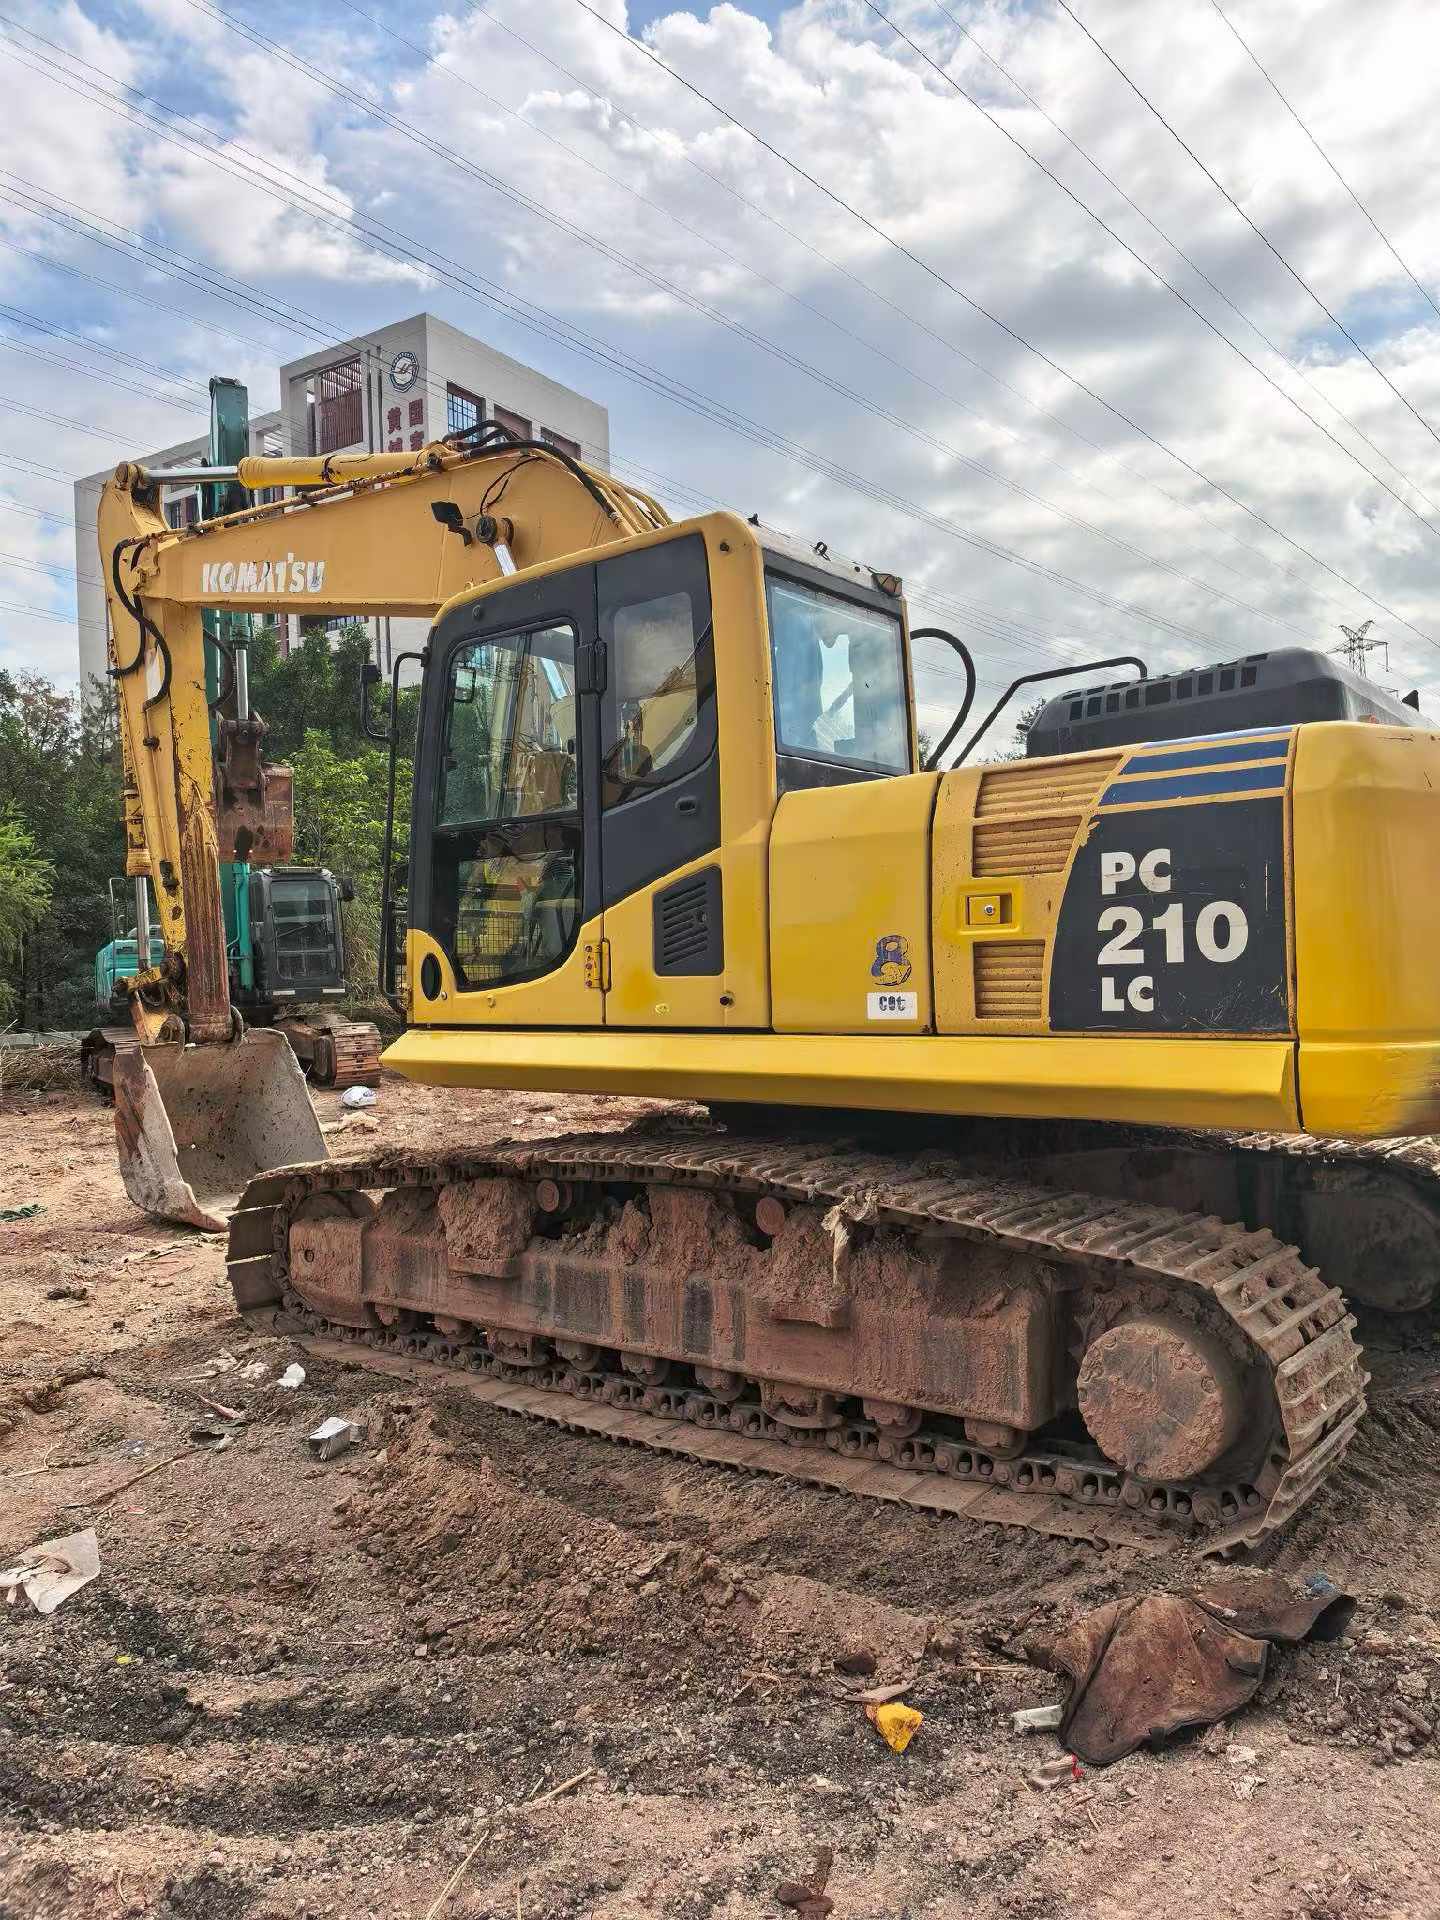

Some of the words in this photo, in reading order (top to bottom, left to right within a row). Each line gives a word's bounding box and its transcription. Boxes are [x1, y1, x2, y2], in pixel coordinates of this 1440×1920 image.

[202, 553, 326, 593] KOMATSU
[1101, 848, 1171, 895] PC
[1097, 900, 1249, 965] 210
[1101, 975, 1154, 1013] LC
